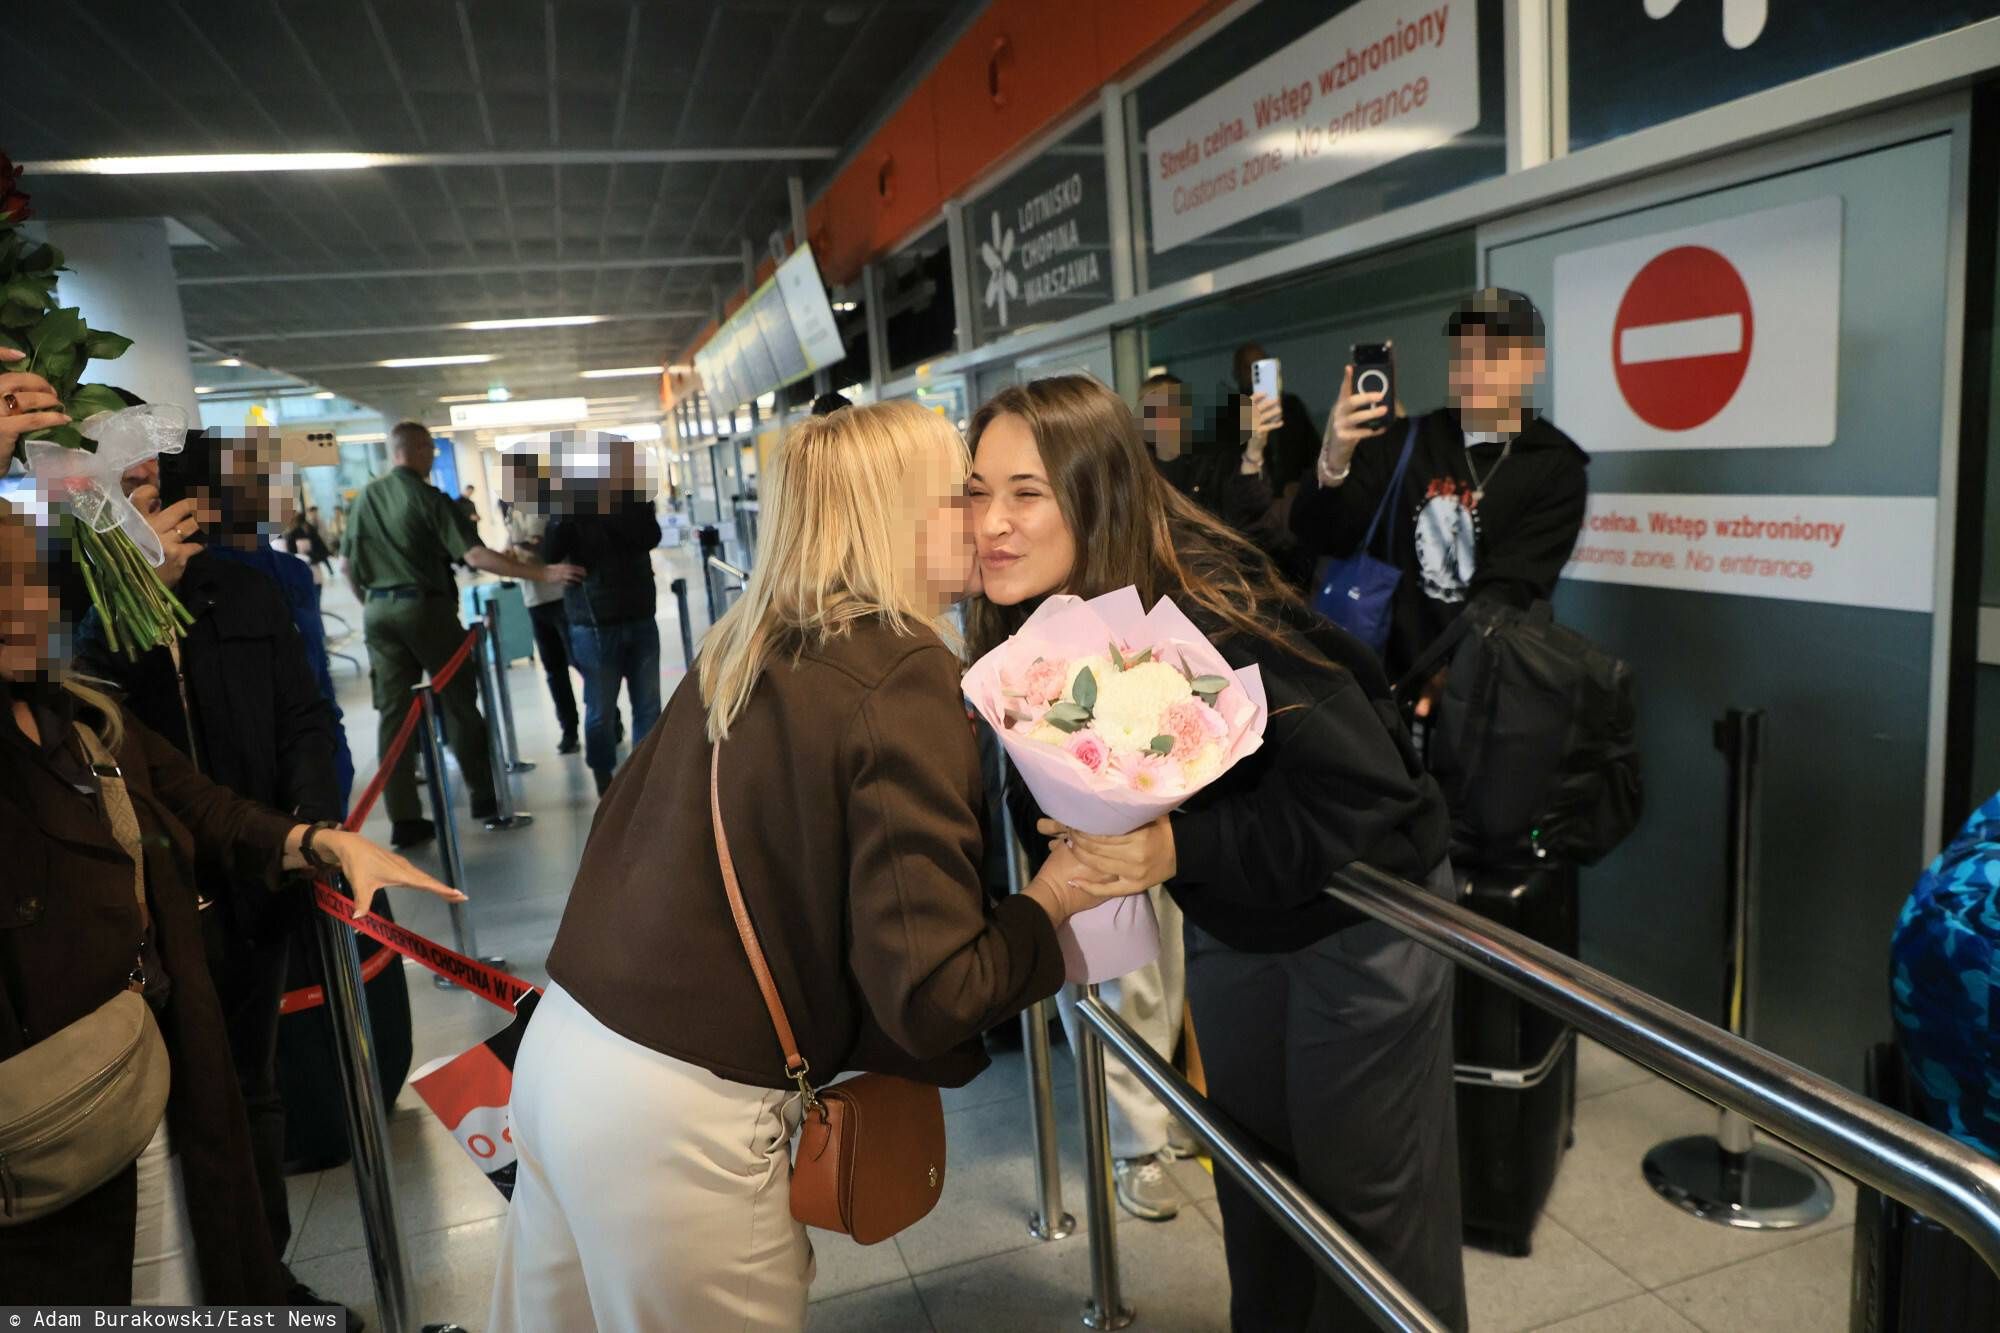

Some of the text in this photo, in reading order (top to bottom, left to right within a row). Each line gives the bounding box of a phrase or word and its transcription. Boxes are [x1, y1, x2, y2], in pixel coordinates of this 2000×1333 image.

[1203, 117, 1250, 158] celna.
[1253, 80, 1313, 130] Wstęp
[1318, 4, 1449, 97] wzbroniony
[1173, 167, 1237, 216] Customs
[1328, 75, 1429, 145] entrance
[1018, 172, 1083, 234] LOTNISKO
[1022, 218, 1081, 271] CHOPINA
[1023, 251, 1101, 307] WARSZAWA
[1589, 510, 1845, 549] celna. Wstęp wzbroniony
[1685, 549, 1715, 573] No
[1719, 554, 1814, 580] entrance
[431, 946, 492, 994] CHOPINA
[494, 975, 509, 1001] W
